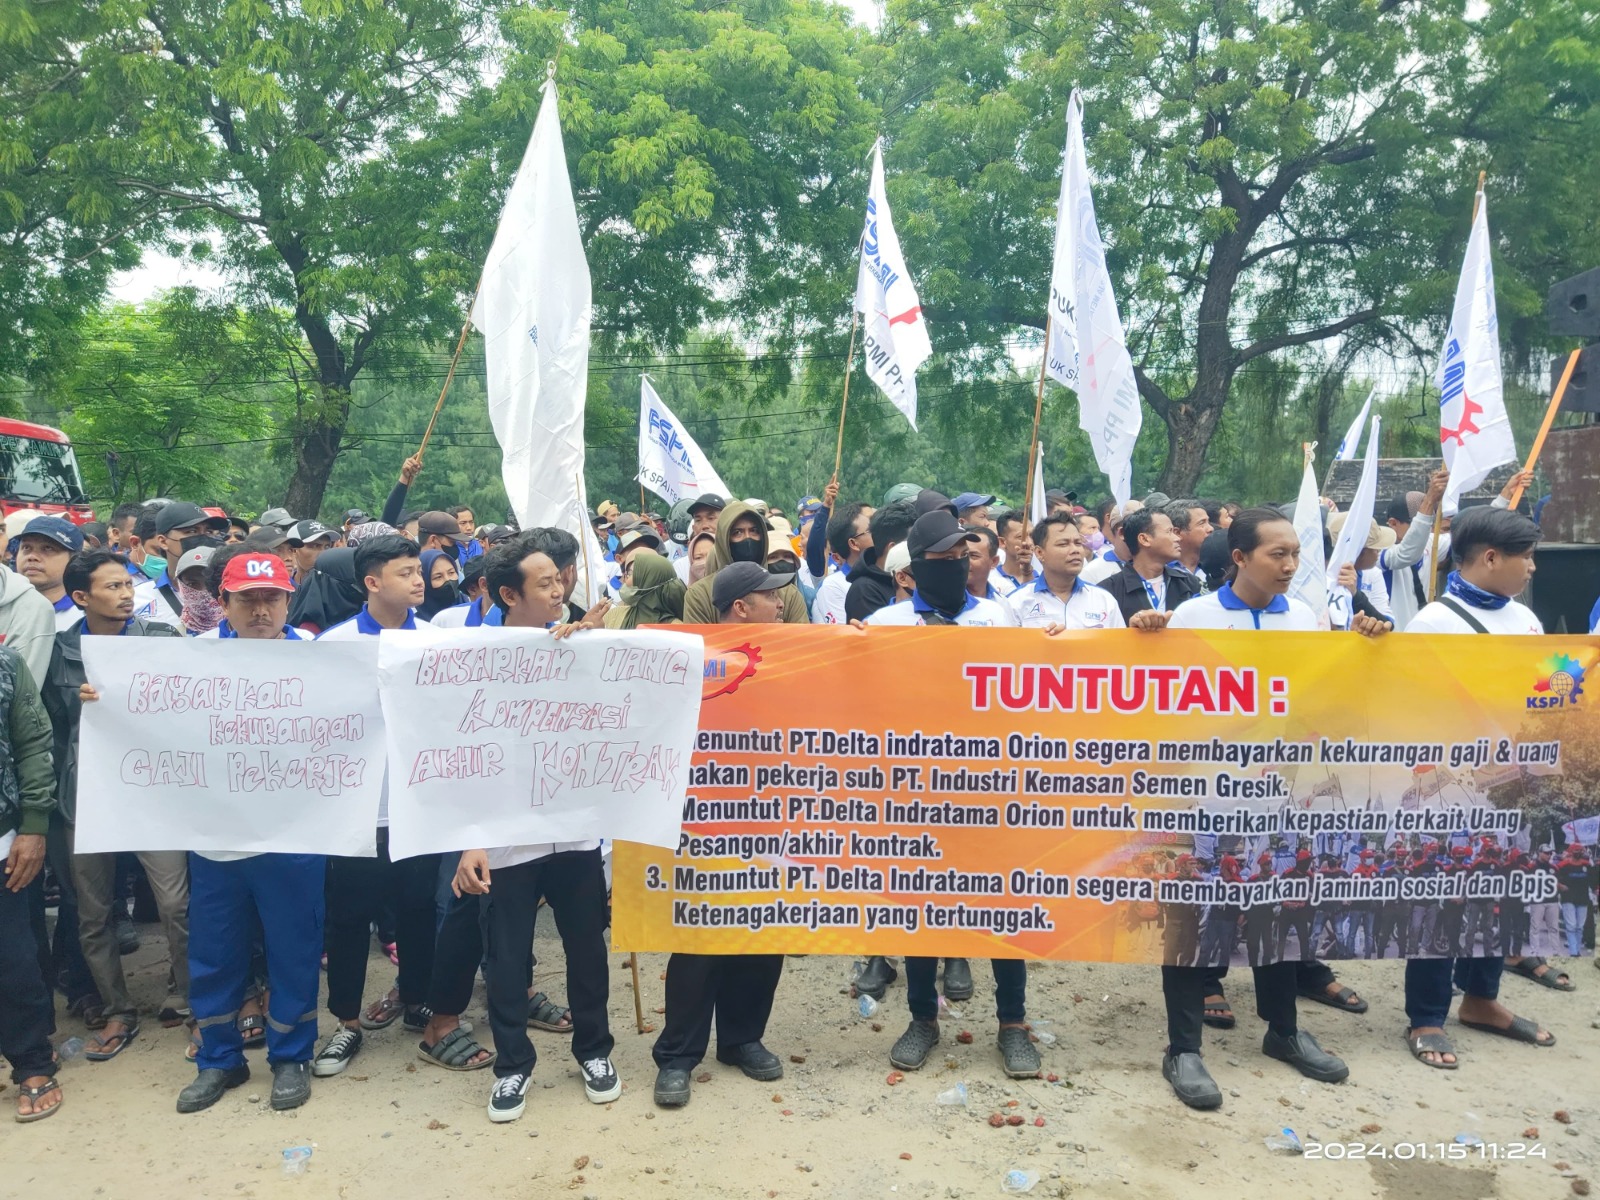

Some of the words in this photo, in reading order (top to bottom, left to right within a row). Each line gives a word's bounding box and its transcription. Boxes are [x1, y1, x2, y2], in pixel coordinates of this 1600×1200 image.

[245, 559, 275, 578] 04
[963, 664, 1257, 714] TUNTUTAN
[1525, 696, 1565, 709] KSPI
[692, 729, 783, 754] enuntut
[789, 729, 880, 756] PT.Delta
[886, 731, 1001, 759] indratama
[1007, 733, 1068, 760] Orion
[1074, 740, 1151, 766] segera
[1157, 737, 1314, 769] membayarkan
[1319, 738, 1444, 768] kekurangan
[1449, 739, 1490, 769] gaji
[1494, 738, 1511, 764] &
[1517, 742, 1560, 769] uang
[756, 762, 839, 793] pekerja
[844, 765, 885, 790] sub
[891, 766, 924, 791] PT.
[931, 767, 1018, 793] Industri
[1024, 769, 1125, 795] Kemasan
[1131, 770, 1208, 797] Semen
[1215, 772, 1289, 800] Gresik.
[681, 796, 782, 823] Menuntut
[788, 796, 878, 823] PT.Delta
[884, 799, 999, 826] Indratama
[1005, 801, 1065, 828] Orion
[1071, 804, 1137, 829] untuk
[1143, 805, 1281, 836] memberikan
[1282, 804, 1389, 838] kepastian
[1394, 807, 1466, 834] terkait
[1469, 804, 1522, 836] Uang
[850, 832, 942, 858] kontrak.
[645, 864, 668, 890] 3.
[674, 866, 781, 893] Menuntut
[786, 865, 819, 890] PT.
[825, 865, 883, 892] Delta
[890, 867, 1004, 894] Indratama
[1010, 869, 1070, 896] Orion
[1075, 877, 1153, 903] segera
[1160, 875, 1307, 906] membayarkan
[1312, 873, 1397, 902] jaminan
[1402, 871, 1461, 897] sosial
[1466, 870, 1504, 897] dan
[1510, 870, 1557, 899] Bpjs
[673, 900, 860, 931] Ketenagakerjaan
[865, 906, 919, 932] yang
[924, 903, 1054, 934] tertunggak.
